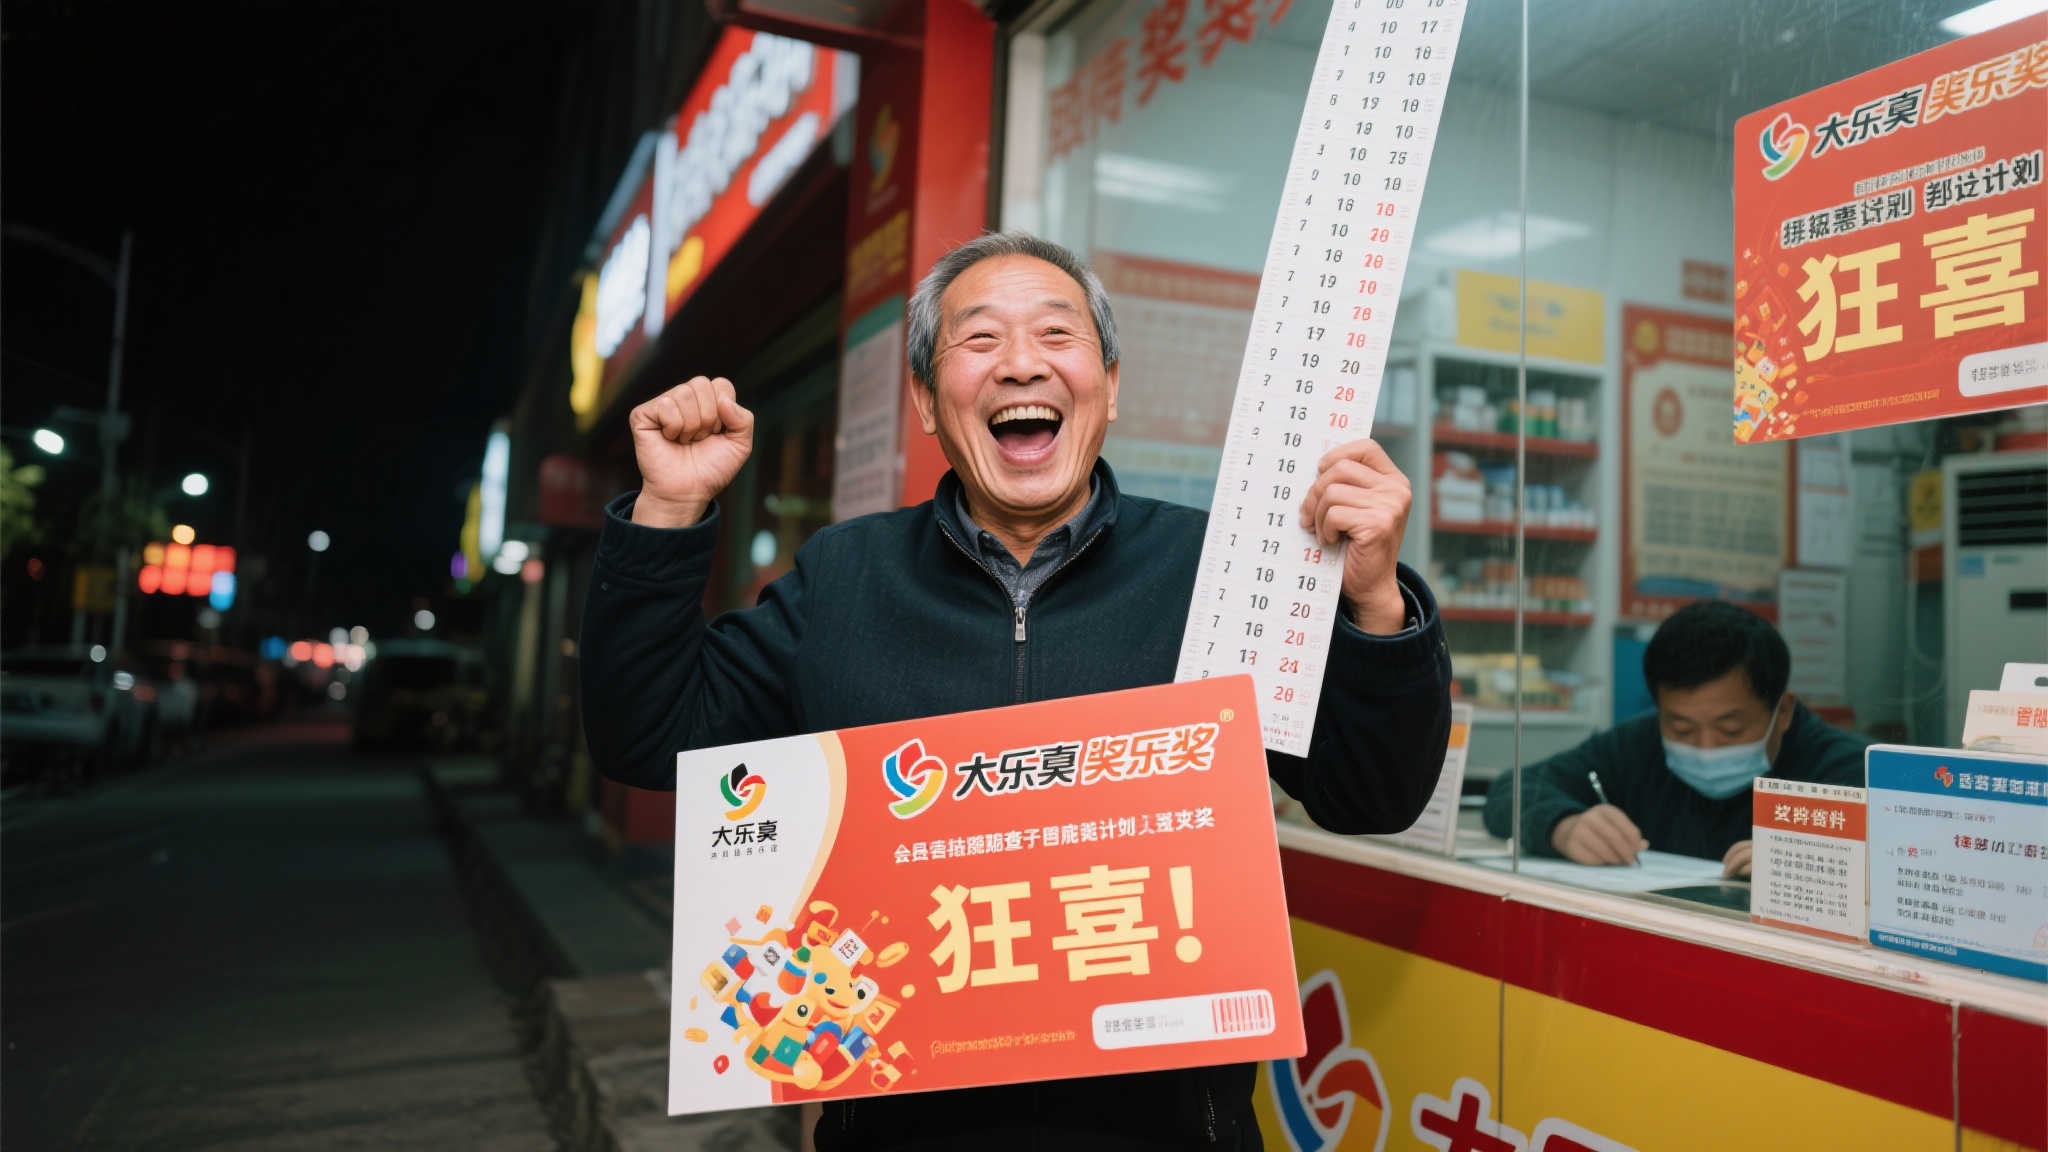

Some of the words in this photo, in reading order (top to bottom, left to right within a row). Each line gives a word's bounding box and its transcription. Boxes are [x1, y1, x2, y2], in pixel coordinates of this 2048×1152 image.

[1797, 208, 2039, 362] 狂喜
[1339, 359, 1361, 375] 20
[1289, 601, 1311, 619] 20
[1212, 614, 1221, 629] 7
[1207, 641, 1215, 656] 7
